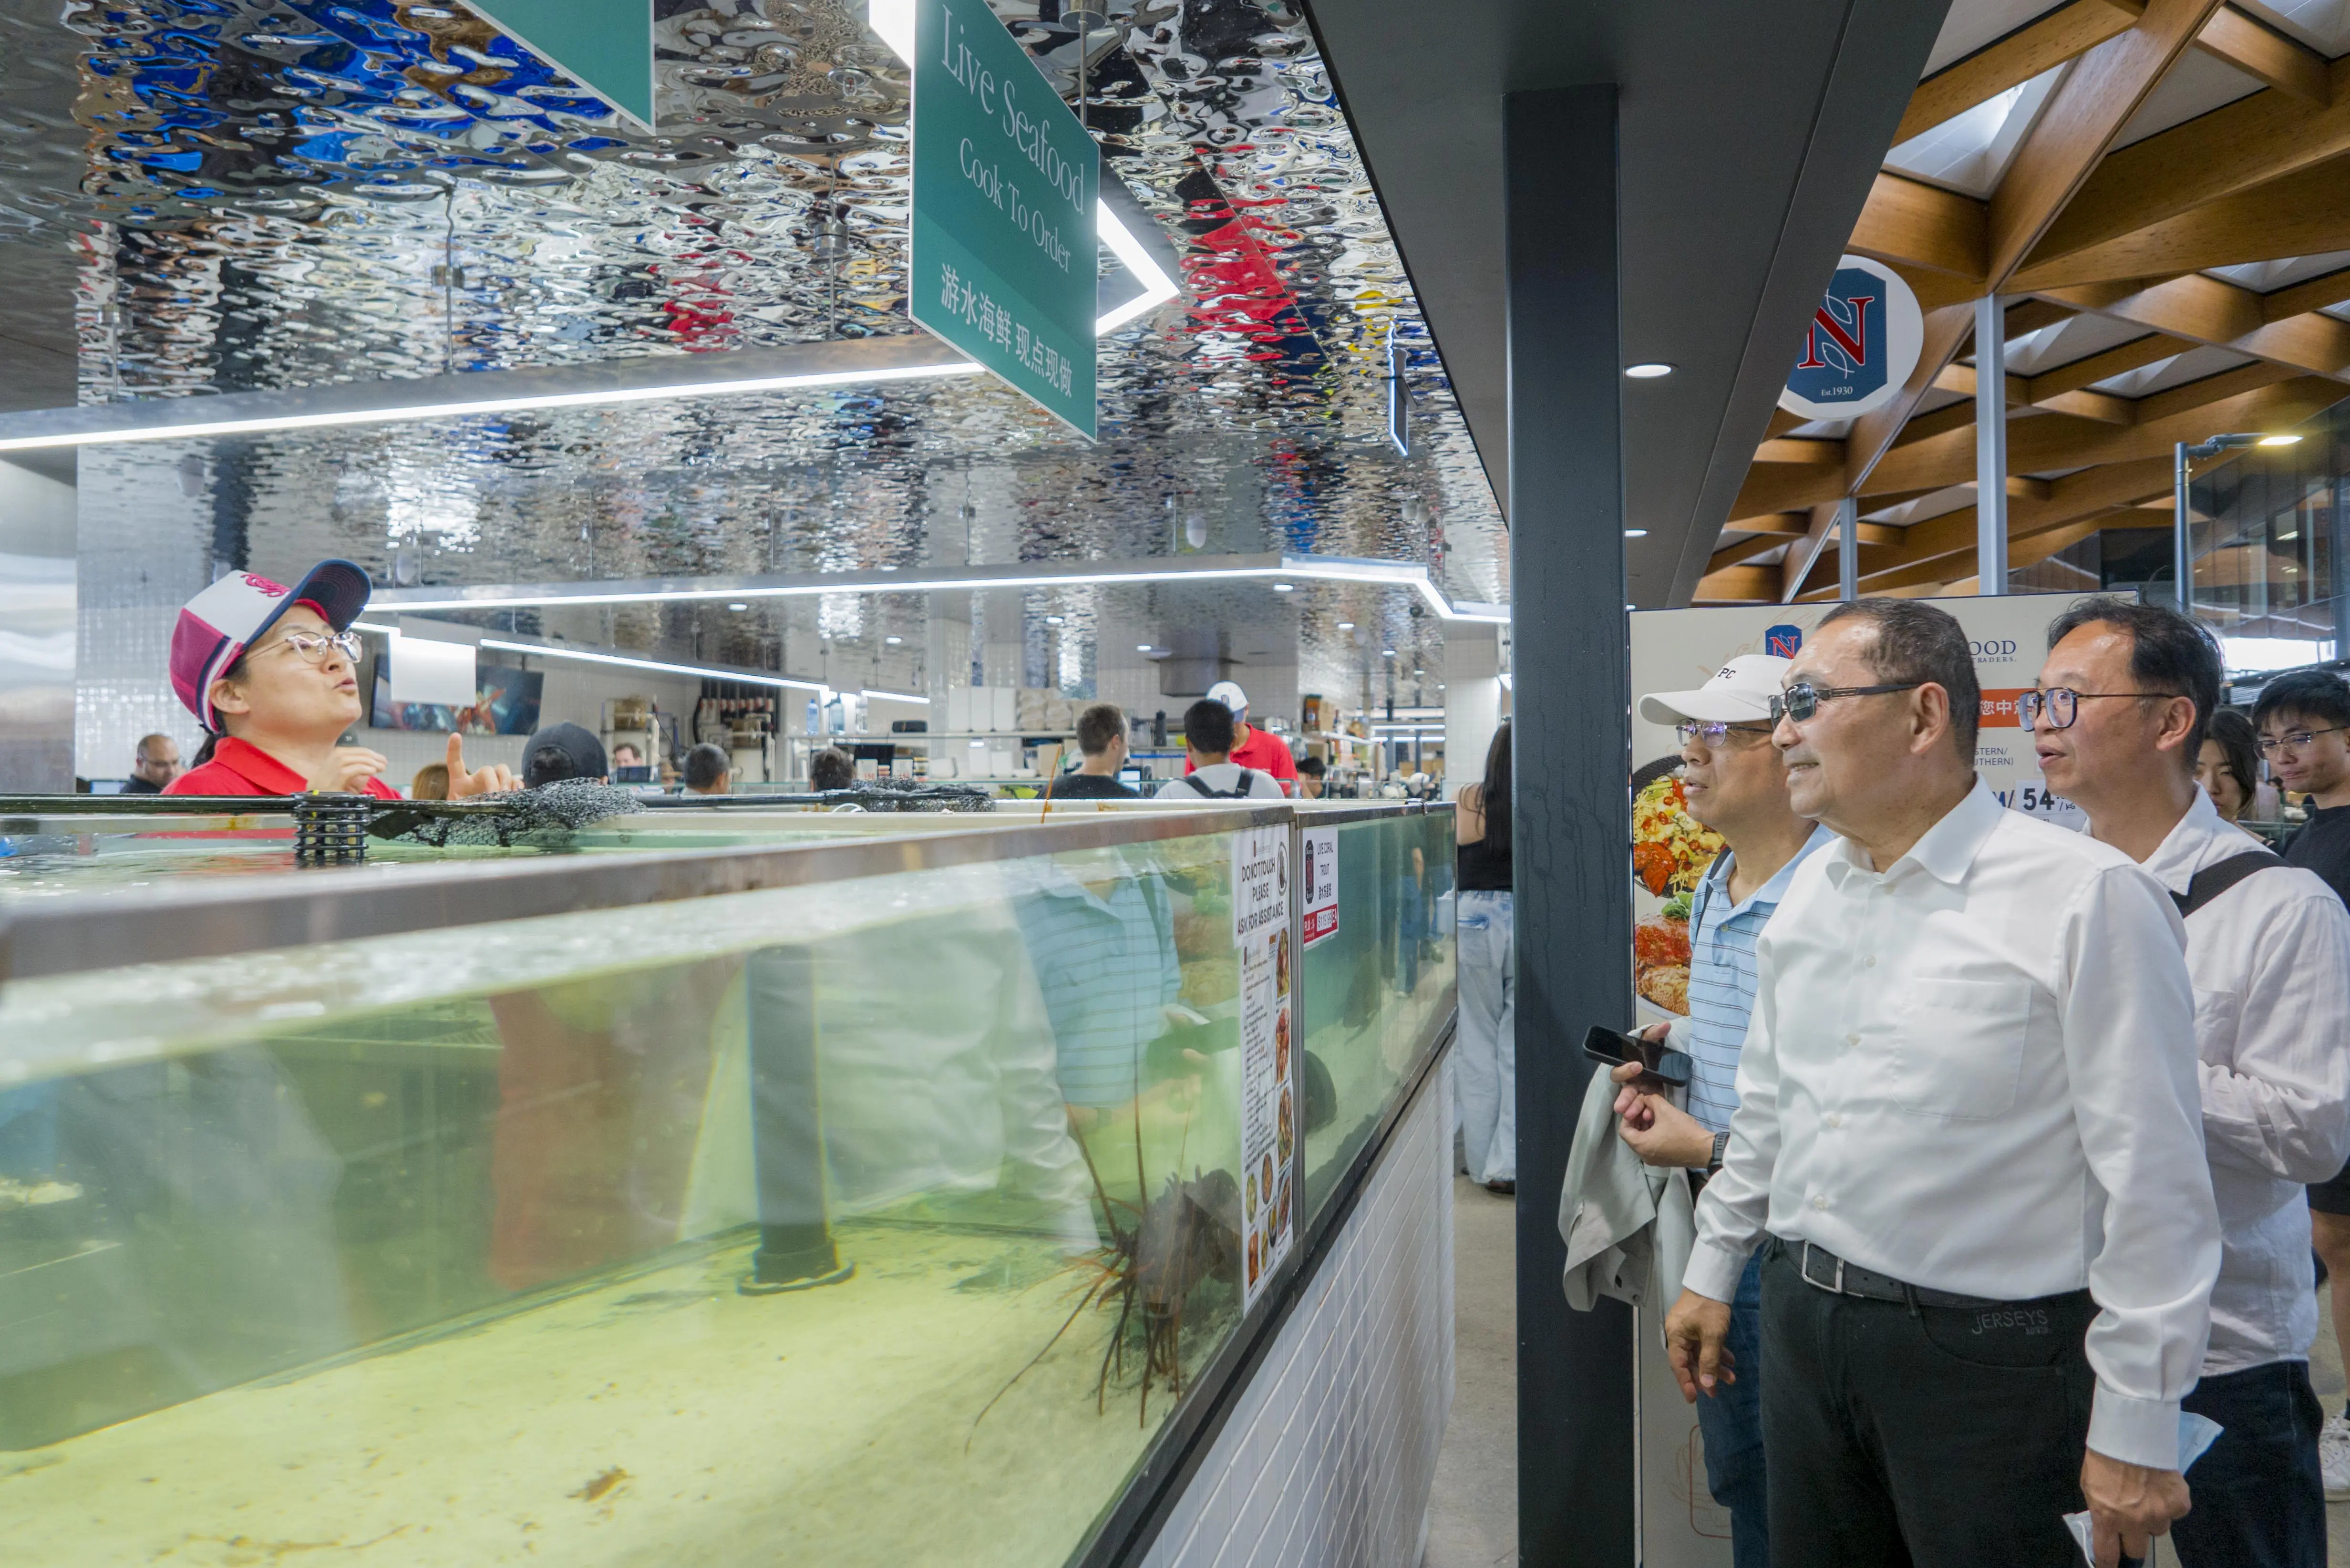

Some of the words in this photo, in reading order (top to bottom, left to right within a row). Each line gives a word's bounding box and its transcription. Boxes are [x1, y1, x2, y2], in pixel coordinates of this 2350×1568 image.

[941, 4, 994, 114] Live
[1003, 80, 1085, 215] Seafood
[959, 137, 1004, 211] Cook
[1008, 179, 1028, 232] To
[1032, 210, 1072, 274] Order
[940, 262, 1011, 354] 游水海鲜
[1016, 322, 1073, 399] 现点现做
[1797, 295, 1875, 369] N
[1769, 636, 1798, 660] N
[1324, 841, 1333, 854] CORAL
[1242, 864, 1250, 883] DO
[1250, 862, 1260, 880] NOT
[1260, 857, 1276, 877] TOUCH
[1320, 863, 1330, 877] TROUT
[1252, 882, 1269, 903] PLEASE
[1237, 916, 1248, 936] ASK
[1248, 912, 1257, 930] FOR
[1258, 900, 1284, 926] ASSISTANCE
[1972, 1309, 2048, 1335] JERSEYS
